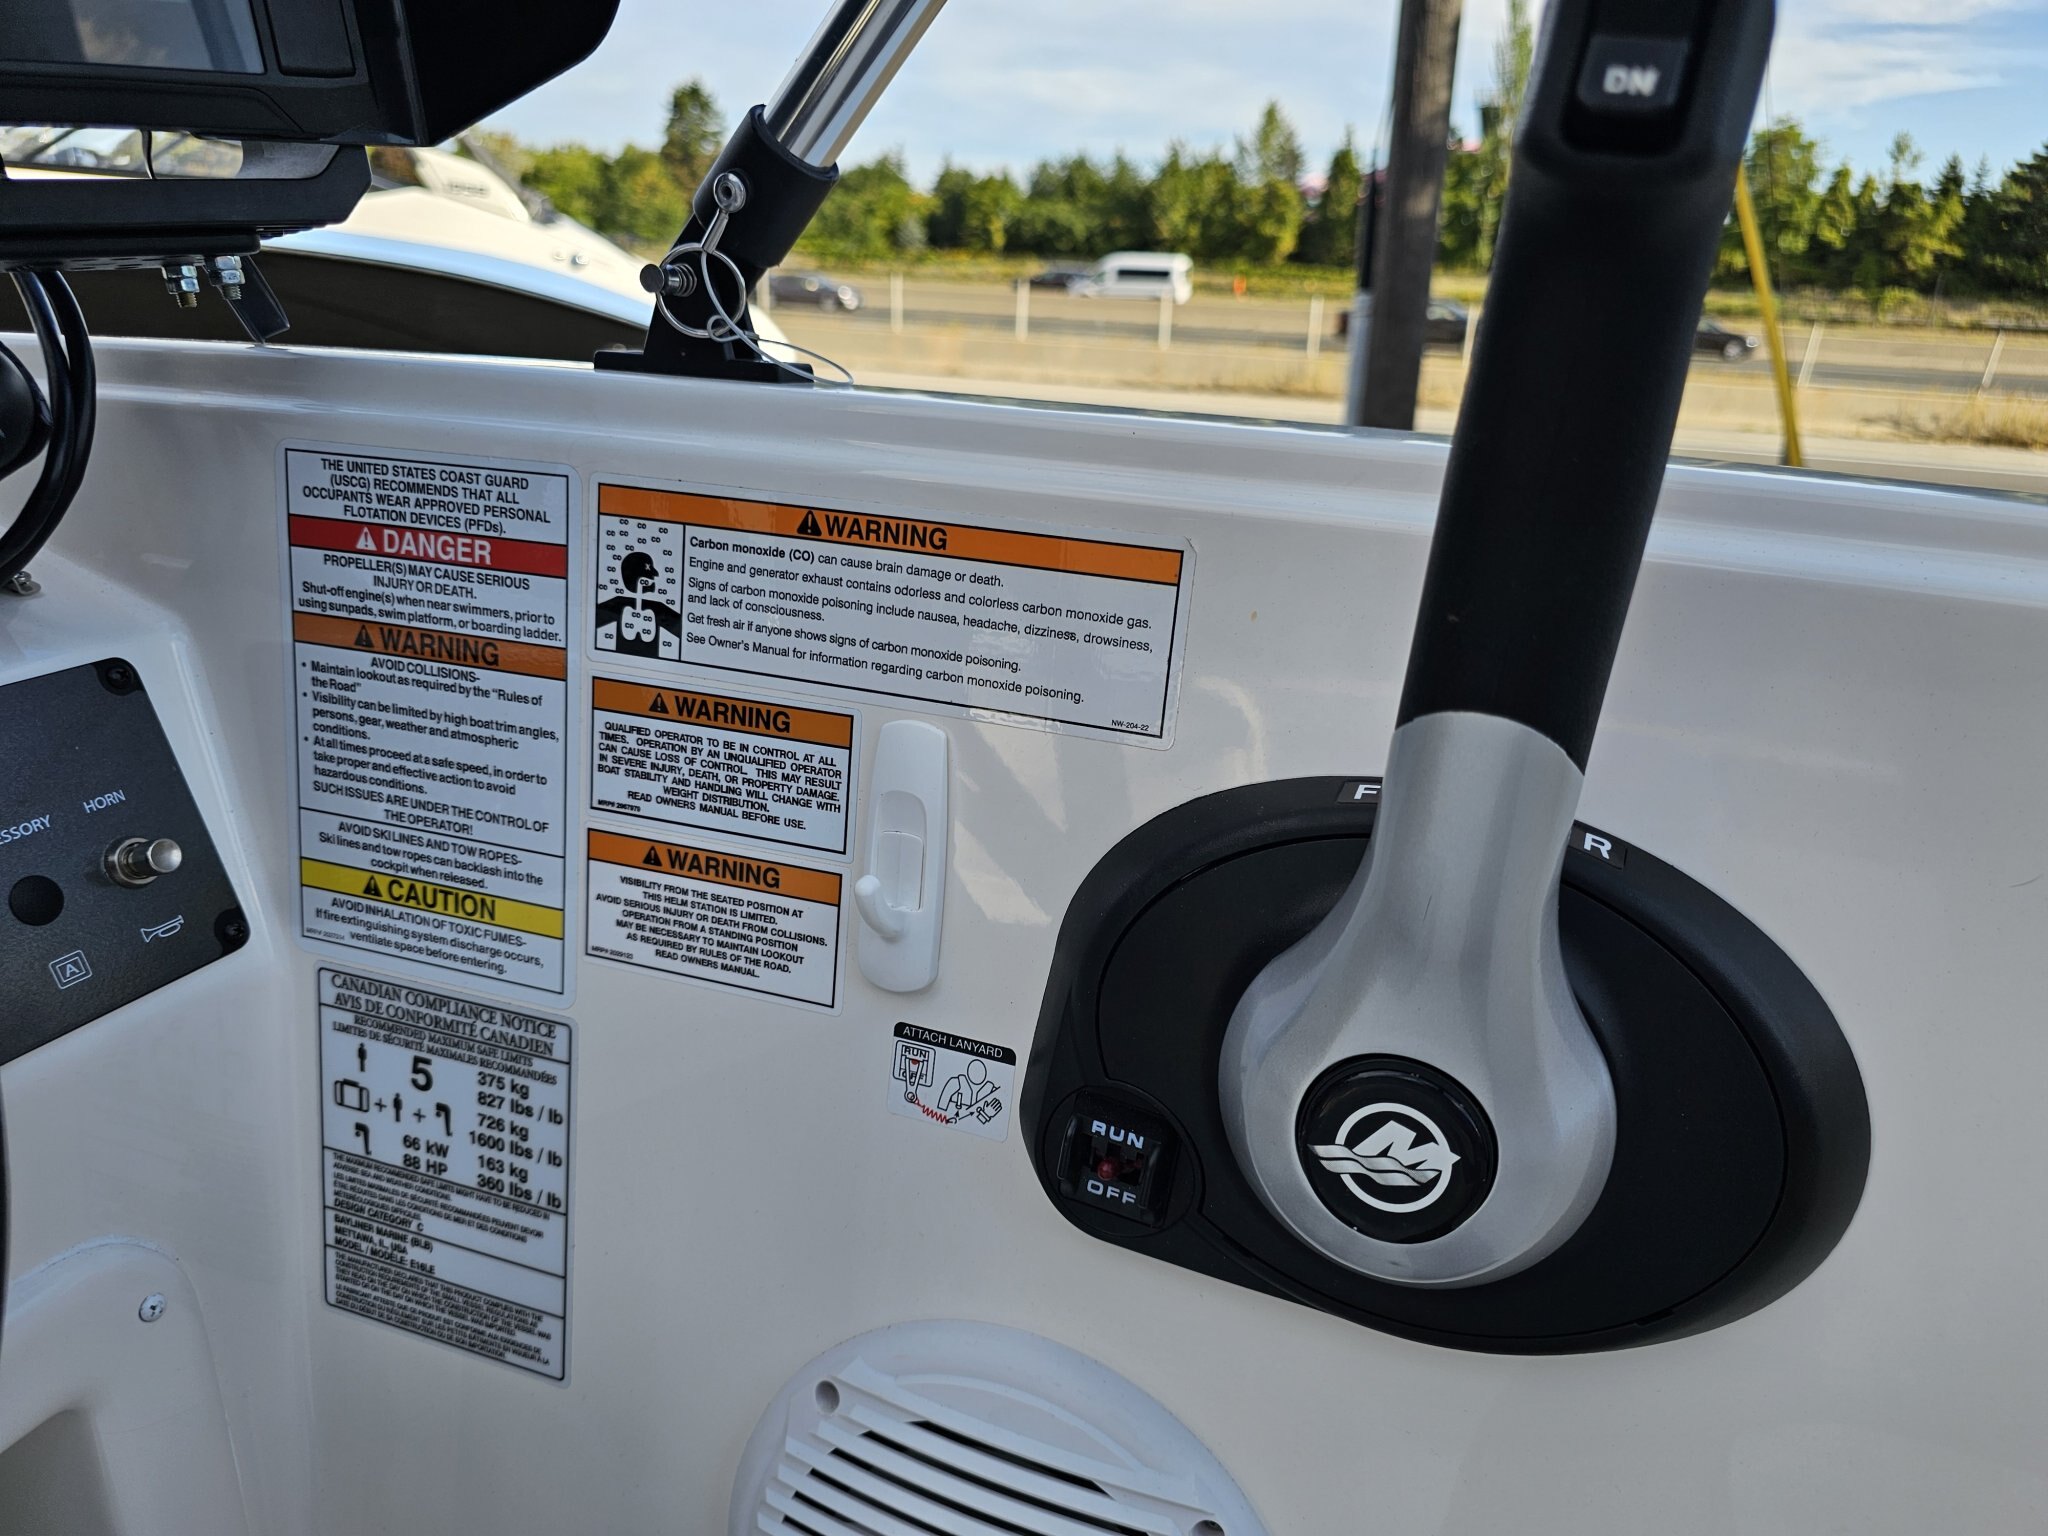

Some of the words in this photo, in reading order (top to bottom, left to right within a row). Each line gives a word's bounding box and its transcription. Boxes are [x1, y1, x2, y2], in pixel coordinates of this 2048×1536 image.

[1603, 64, 1660, 96] DN
[321, 458, 343, 471] THE
[346, 461, 389, 476] UNITED
[391, 465, 436, 481] STATES
[439, 470, 479, 485] COAST
[484, 474, 529, 490] GUARD
[330, 474, 370, 493] (USCG)
[372, 478, 458, 498] RECOMMENDS
[462, 487, 491, 501] THAT
[496, 490, 520, 504] ALL
[303, 486, 373, 504] OCCUPANTS
[375, 494, 411, 508] WEAR
[413, 498, 480, 515] APPROVED
[483, 505, 551, 523] PERSONAL
[344, 505, 406, 523] FLOTATION
[409, 512, 461, 529] DEVICES
[463, 518, 506, 536] (PFDs).
[383, 530, 492, 565] DANGER
[825, 514, 948, 550] WARNING
[323, 554, 406, 575] PROPELLER(S)
[407, 564, 431, 578] MAY
[433, 567, 474, 583] CAUSE
[476, 571, 530, 589] SERIOUS
[690, 537, 729, 552] Carbon
[731, 542, 785, 559] monoxide
[788, 549, 814, 565] (CO)
[817, 555, 837, 566] can
[840, 557, 872, 570] cause
[875, 559, 903, 574] brain
[905, 563, 951, 583] damage
[954, 571, 966, 582] or
[968, 571, 1004, 587] death.
[373, 576, 413, 591] INJURY
[415, 581, 432, 594] OR
[434, 583, 477, 599] DEATH.
[689, 557, 724, 574] Engine
[726, 562, 746, 574] and
[748, 564, 799, 584] generator
[801, 571, 843, 587] exhaust
[845, 577, 891, 594] contains
[894, 583, 941, 600] odorless
[944, 590, 965, 604] and
[968, 593, 1019, 611] colorless
[1022, 600, 1062, 617] carbon
[1065, 606, 1123, 625] monoxide
[1126, 616, 1152, 631] gas.
[687, 592, 707, 604] and
[709, 595, 729, 608] lack
[732, 598, 742, 609] of
[744, 600, 825, 621] consciousness.
[688, 577, 716, 593] Signs
[718, 581, 728, 593] of
[730, 582, 766, 598] carbon
[768, 588, 819, 605] monoxide
[821, 595, 873, 615] poisoning
[875, 602, 914, 618] include
[917, 610, 960, 625] nausea,
[962, 614, 1020, 633] headache,
[1023, 622, 1079, 641] dizziness,
[1083, 631, 1153, 652] drowsiness,
[379, 627, 499, 666] WARNING
[687, 612, 704, 625] Get
[706, 615, 730, 629] fresh
[732, 619, 744, 631] air
[746, 621, 753, 632] if
[754, 624, 792, 641] anyone
[794, 628, 827, 643] shows
[829, 633, 856, 650] signs
[858, 637, 869, 649] of
[871, 639, 908, 655] carbon
[910, 644, 962, 663] monoxide
[965, 652, 1021, 674] poisoning.
[686, 632, 705, 645] See
[707, 636, 749, 652] Owner's
[752, 642, 789, 658] Manual
[792, 648, 806, 660] for
[809, 651, 868, 670] information
[870, 660, 922, 680] regarding
[925, 668, 963, 684] carbon
[966, 674, 1022, 693] monoxide
[1024, 683, 1084, 705] poisoning.
[674, 695, 791, 733] WARNING
[1111, 720, 1149, 731] NW-204-22
[604, 722, 651, 739] QUALIFIED
[653, 729, 703, 746] OPERATOR
[707, 737, 719, 748] TO
[722, 739, 735, 751] BE
[738, 742, 749, 753] IN
[752, 744, 800, 761] CONTROL
[802, 751, 813, 763] AT
[818, 754, 837, 767] ALL
[83, 790, 126, 814] HORN
[1353, 784, 1381, 800] F
[627, 791, 652, 804] READ
[654, 796, 695, 811] OWNERS
[698, 803, 738, 818] MANUAL
[741, 810, 780, 825] BEFORE
[783, 817, 806, 830] USE.
[0, 815, 51, 845] SSORY
[1583, 832, 1612, 859] R
[667, 849, 780, 889] WARNING
[388, 880, 496, 920] CAUTION
[619, 876, 661, 892] VISIBILITY
[663, 884, 689, 897] FROM
[691, 889, 708, 901] THE
[710, 892, 744, 908] SEATED
[746, 899, 789, 916] POSITION
[791, 907, 803, 919] AT
[655, 949, 678, 962] READ
[680, 954, 718, 970] OWNERS
[720, 961, 760, 978] MANUAL.
[331, 974, 401, 1003] CANADIAN
[404, 991, 496, 1025] COMPLIANCE
[500, 1012, 557, 1039] NOTICE
[334, 992, 362, 1011] AVIS
[364, 999, 382, 1016] DE
[479, 1026, 554, 1056] CANADIEN
[903, 1026, 947, 1045] ATTACH
[949, 1037, 1003, 1058] LANYARD
[410, 1055, 433, 1092] 5
[477, 1071, 505, 1090] 375
[510, 1078, 530, 1100] kg
[477, 1091, 505, 1110] 827
[510, 1099, 534, 1117] lbs
[549, 1109, 563, 1125] lb
[477, 1113, 505, 1131] 726
[510, 1119, 529, 1141] kg
[1091, 1120, 1144, 1149] RUN
[403, 1135, 421, 1150] 66
[426, 1138, 450, 1158] kW
[469, 1131, 505, 1151] 1600
[510, 1140, 533, 1160] lbs
[548, 1150, 563, 1168] lb
[403, 1154, 421, 1170] 88
[426, 1159, 448, 1176] HP
[477, 1154, 505, 1174] 163
[509, 1163, 528, 1183] kg
[477, 1173, 505, 1193] 360
[509, 1182, 533, 1201] lbs
[547, 1192, 561, 1209] lb
[1087, 1180, 1137, 1205] OFF
